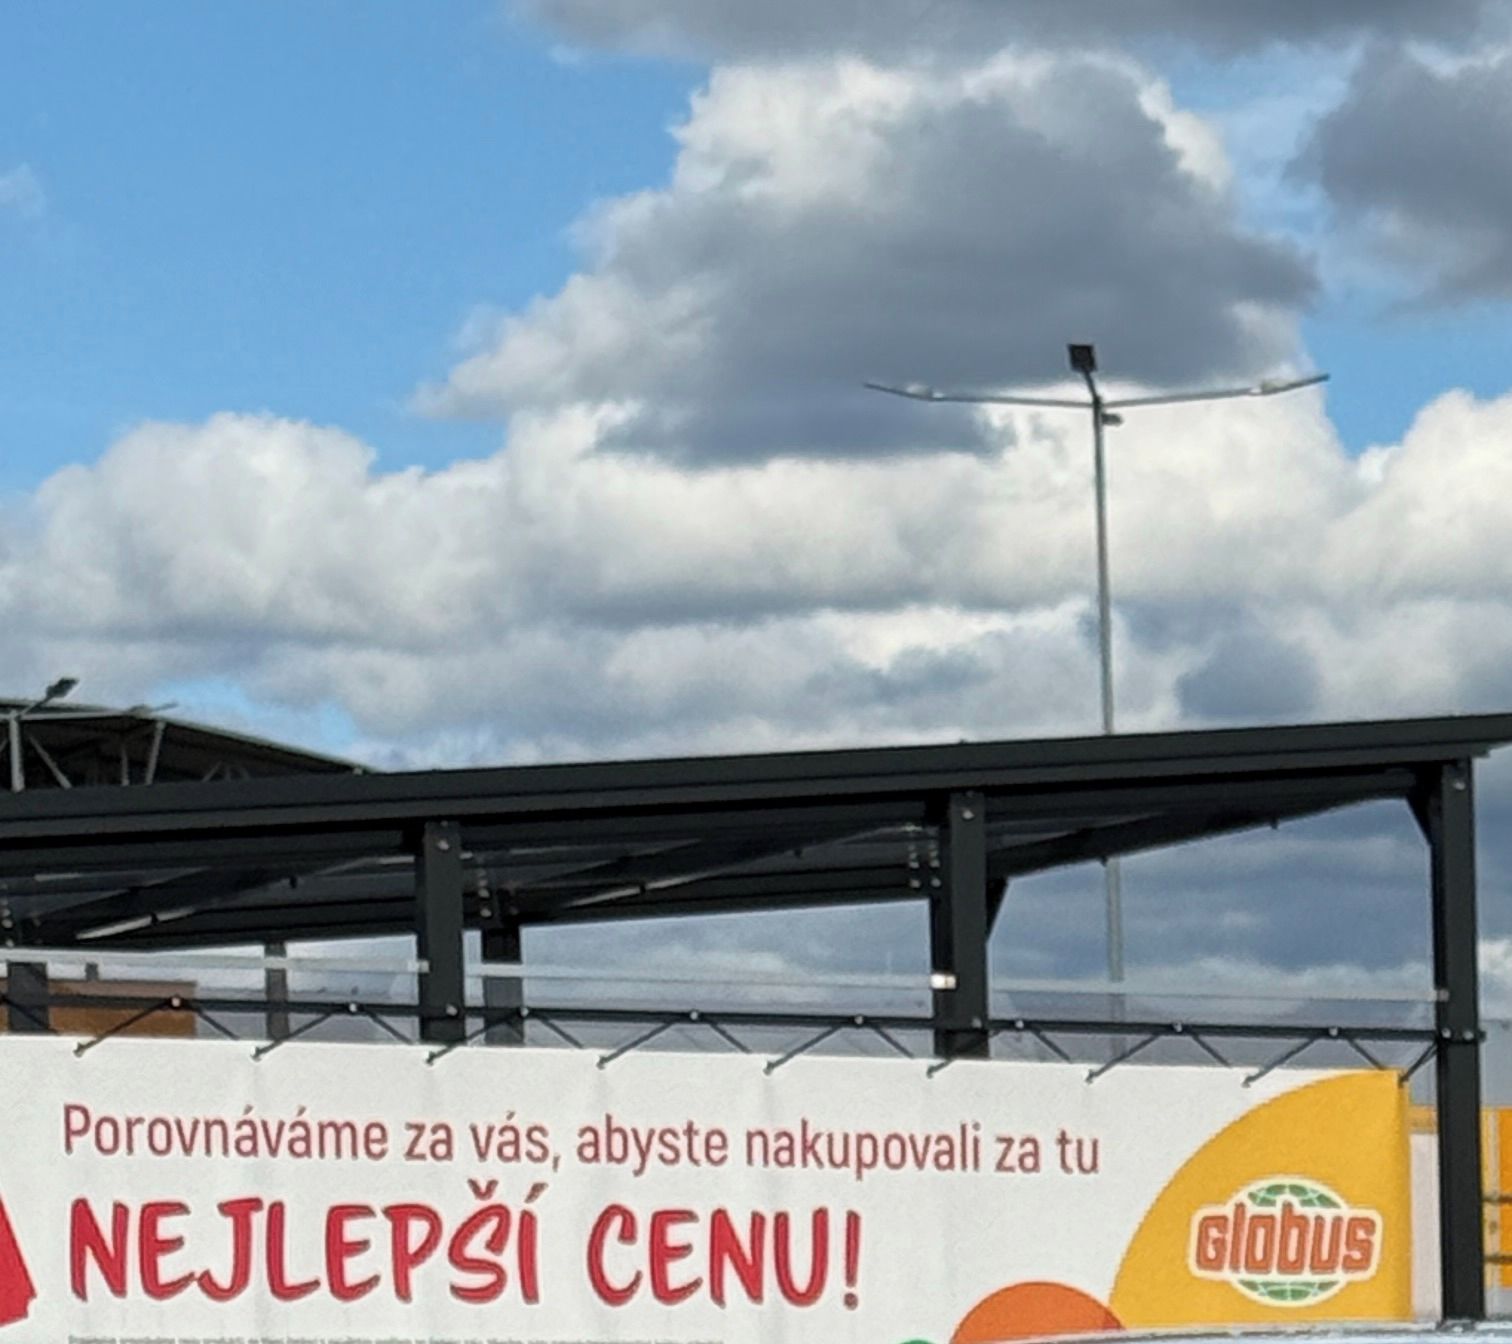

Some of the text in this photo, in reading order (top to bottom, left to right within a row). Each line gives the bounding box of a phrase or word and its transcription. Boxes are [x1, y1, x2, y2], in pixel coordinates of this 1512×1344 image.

[62, 1103, 1100, 1179] Porovnáváme za vás, abyste nakupovali za tu
[69, 1179, 862, 1309] NEJLEPŠÍ CENU!
